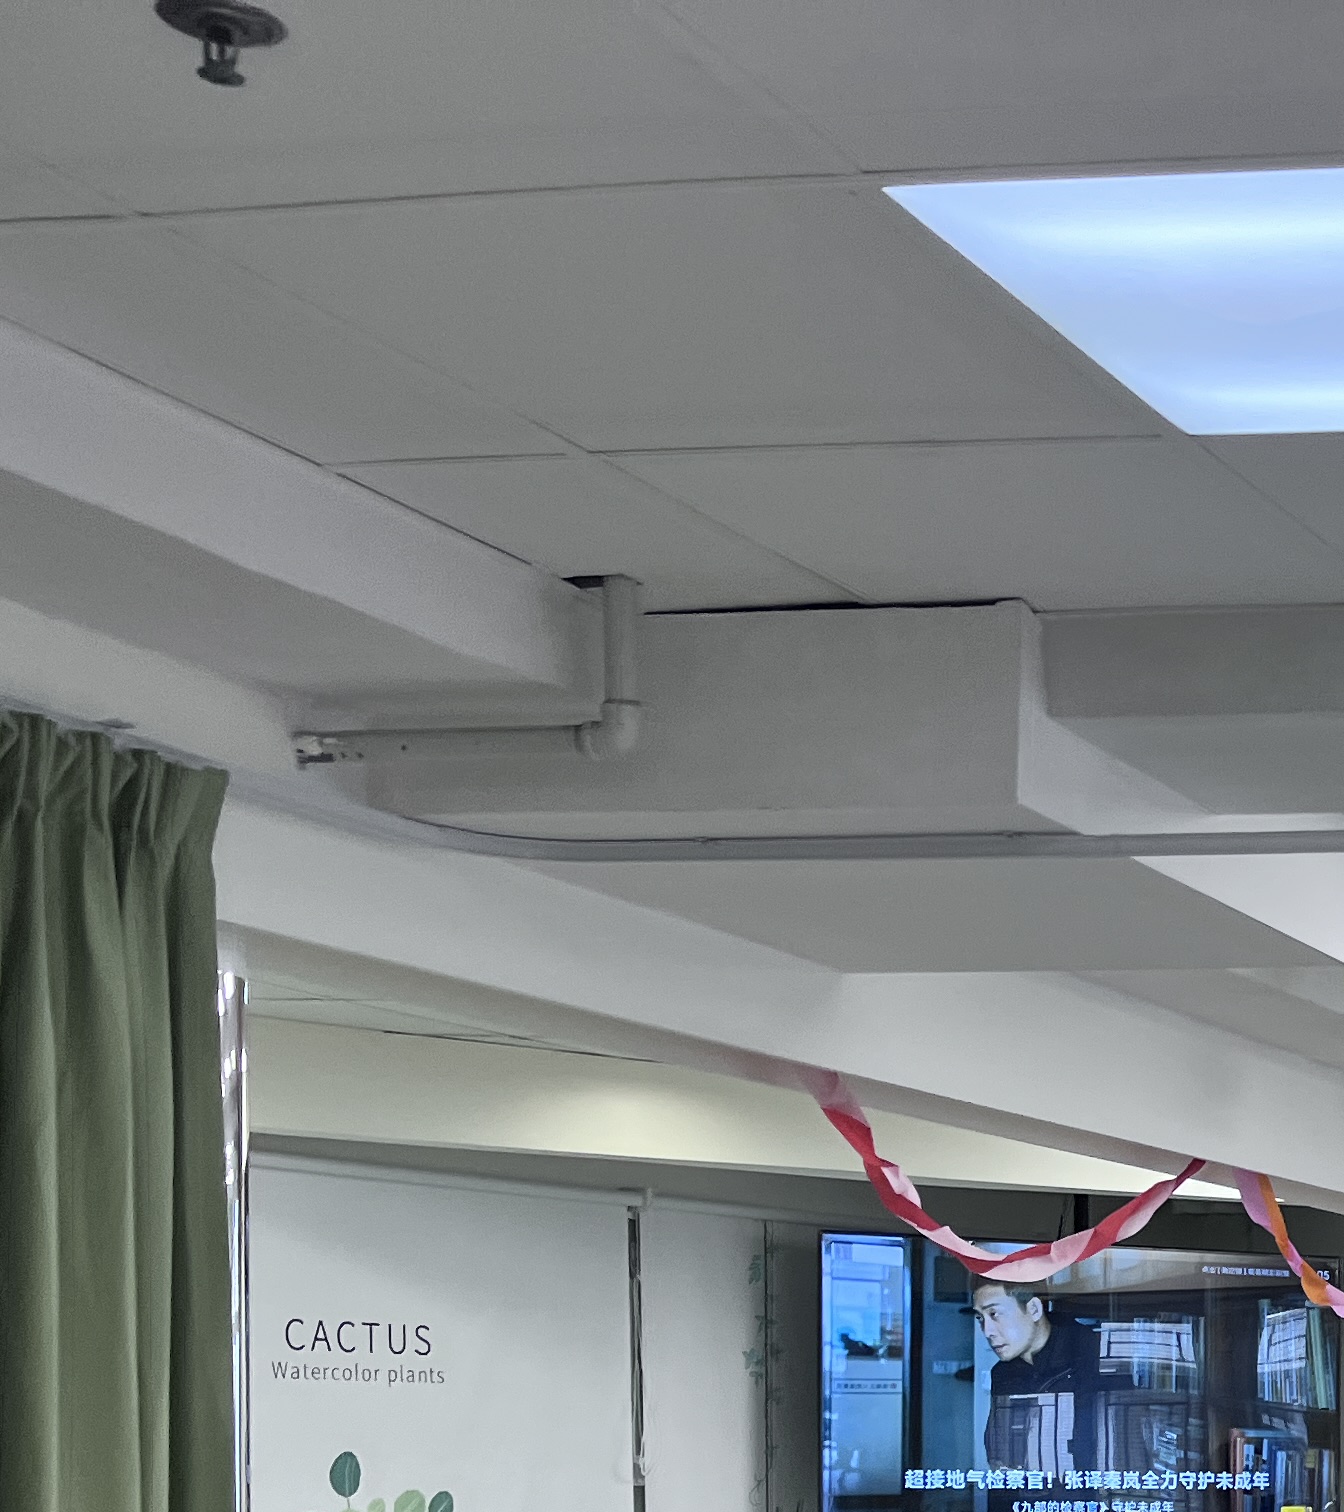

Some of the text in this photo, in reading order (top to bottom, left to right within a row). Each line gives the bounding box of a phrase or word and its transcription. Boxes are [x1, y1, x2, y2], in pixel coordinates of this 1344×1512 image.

[284, 1318, 432, 1356] CACTUS
[271, 1361, 446, 1387] Watercolor plants
